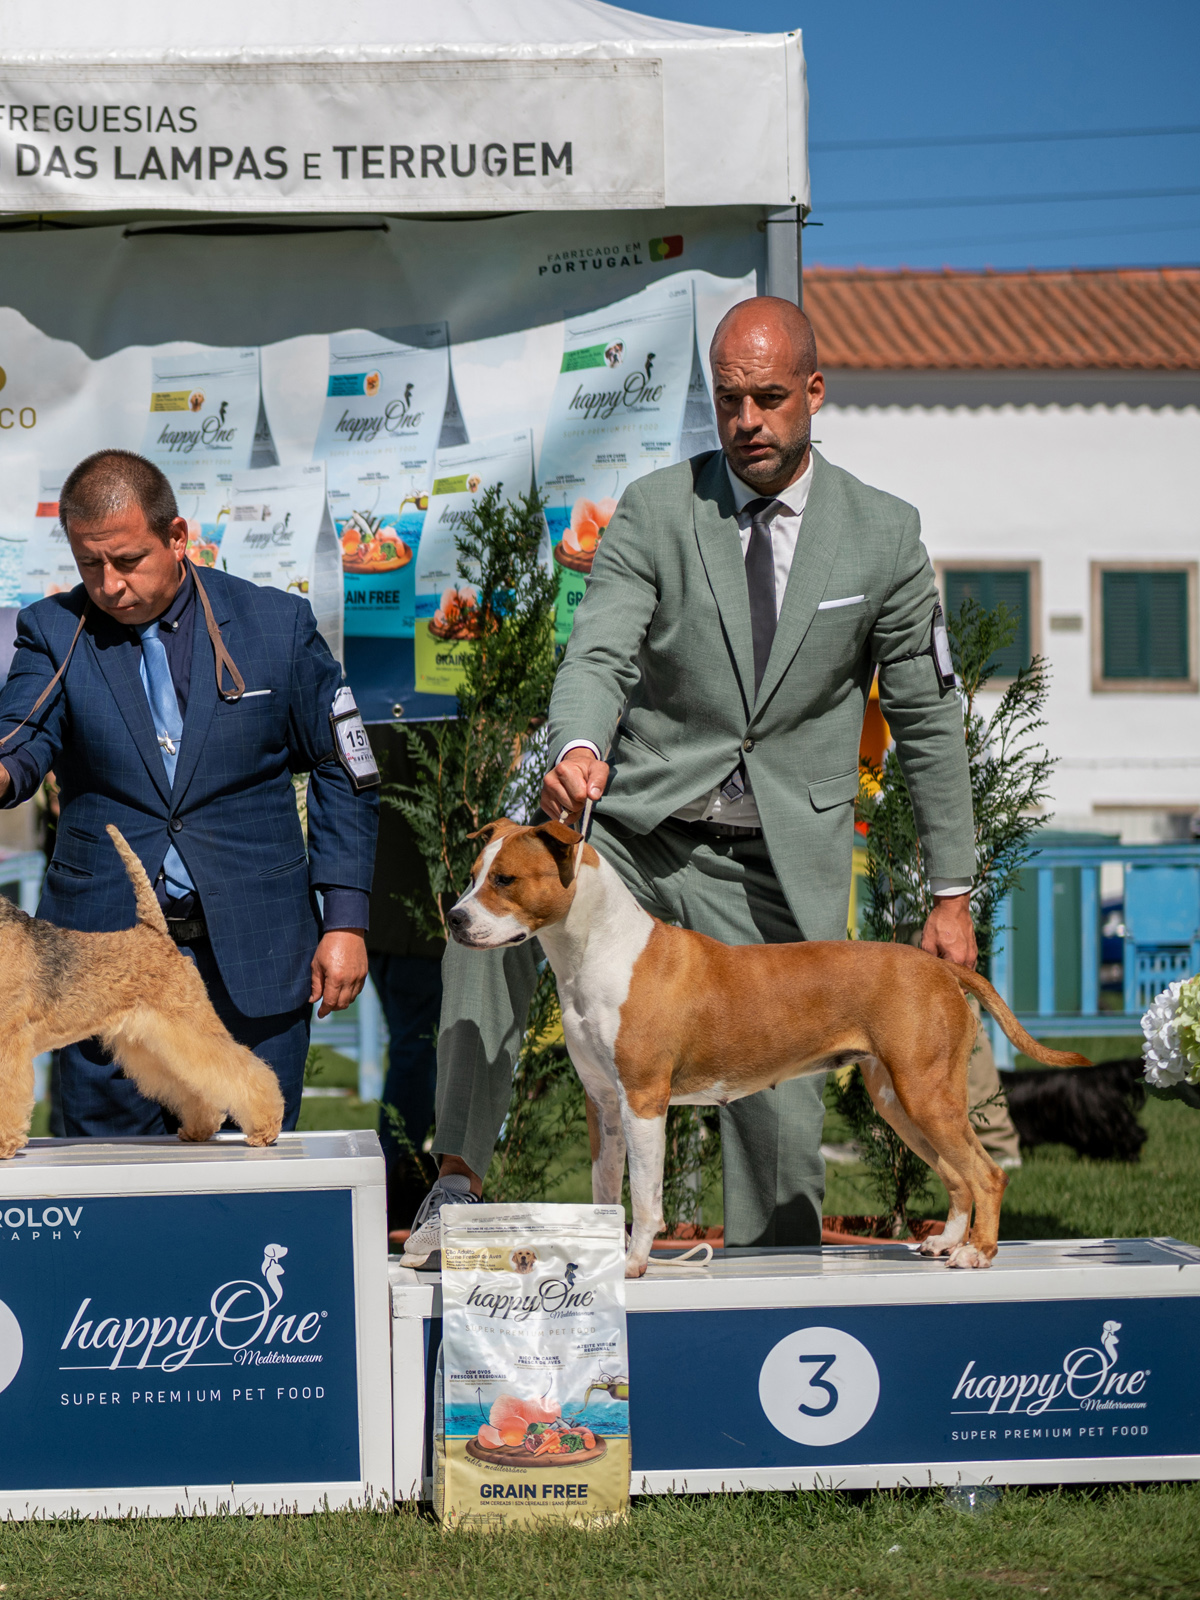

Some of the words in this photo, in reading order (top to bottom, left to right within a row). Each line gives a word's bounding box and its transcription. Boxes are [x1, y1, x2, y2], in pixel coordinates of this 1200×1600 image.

[16, 144, 98, 179] DAS
[114, 146, 288, 180] LAMPAS
[304, 152, 321, 180] E
[333, 141, 573, 180] TERRUGEM
[547, 246, 620, 262] FABRICADO
[625, 242, 642, 253] EM
[538, 254, 643, 276] PORTUGAL
[345, 590, 366, 604] AIN
[369, 590, 400, 604] FREE
[465, 1325, 495, 1334] SUPER
[500, 1329, 544, 1337] PREMIUM
[550, 1328, 566, 1336] PET
[571, 1327, 596, 1335] FOOD
[233, 1348, 323, 1366] Mediterraneum
[798, 1354, 839, 1418] 3
[60, 1392, 120, 1406] SUPER
[132, 1389, 221, 1404] PREMIUM
[232, 1388, 265, 1401] PET
[277, 1386, 325, 1400] FOOD
[1080, 1398, 1147, 1411] Mediterraneum
[952, 1430, 997, 1441] SUPER
[1004, 1428, 1072, 1440] PREMIUM
[1079, 1426, 1104, 1438] PET
[1112, 1425, 1149, 1437] FOOD
[480, 1484, 537, 1499] GRAIN
[542, 1484, 588, 1498] FREE
